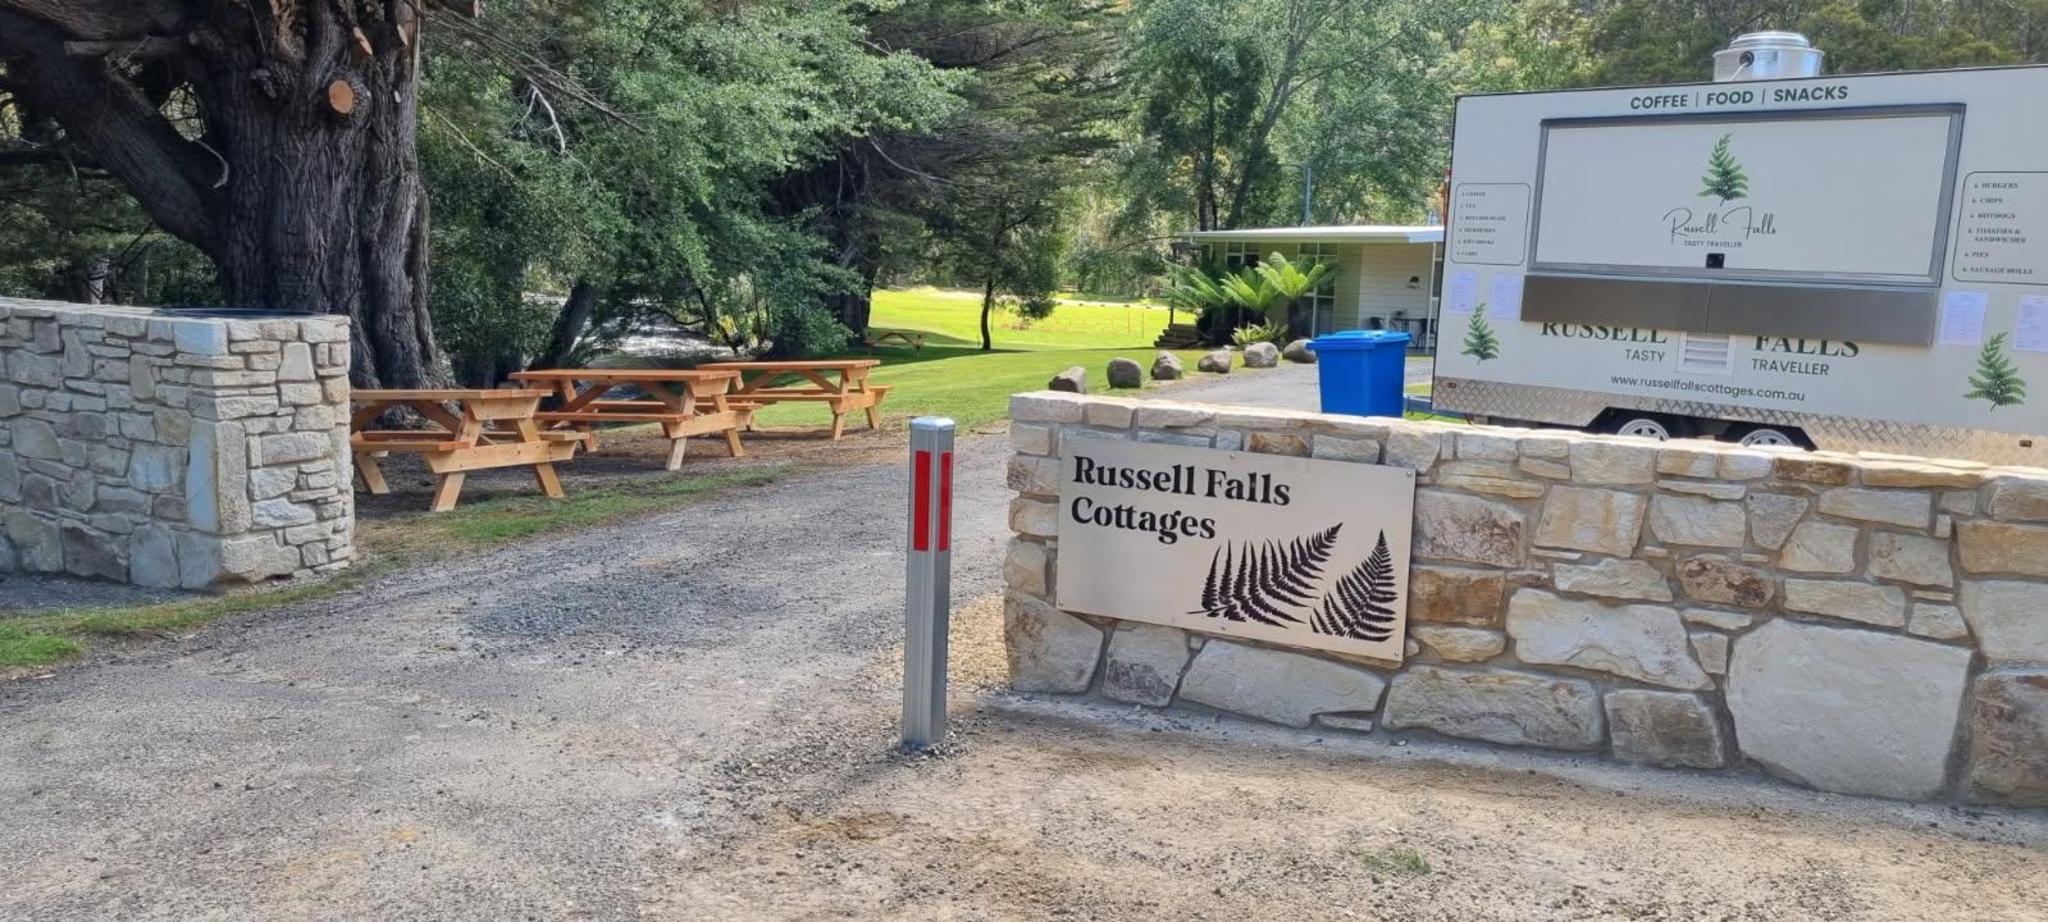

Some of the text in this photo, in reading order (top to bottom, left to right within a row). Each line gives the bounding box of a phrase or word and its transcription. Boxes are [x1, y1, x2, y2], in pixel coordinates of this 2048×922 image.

[1630, 85, 1848, 110] COFFEE FOOD SNACKS
[1662, 206, 1778, 244] Russell Falls
[1706, 240, 1742, 248] TRAVELLER
[1541, 321, 1667, 344] RUSSELL
[1625, 349, 1666, 362] TASTY
[1754, 335, 1859, 358] FALLS
[1751, 358, 1830, 376] TRAVELLER
[1611, 375, 1805, 401] www.russellfallscottages.com.au
[1072, 455, 1291, 506] Russell Falls
[1071, 496, 1216, 545] Cottages
